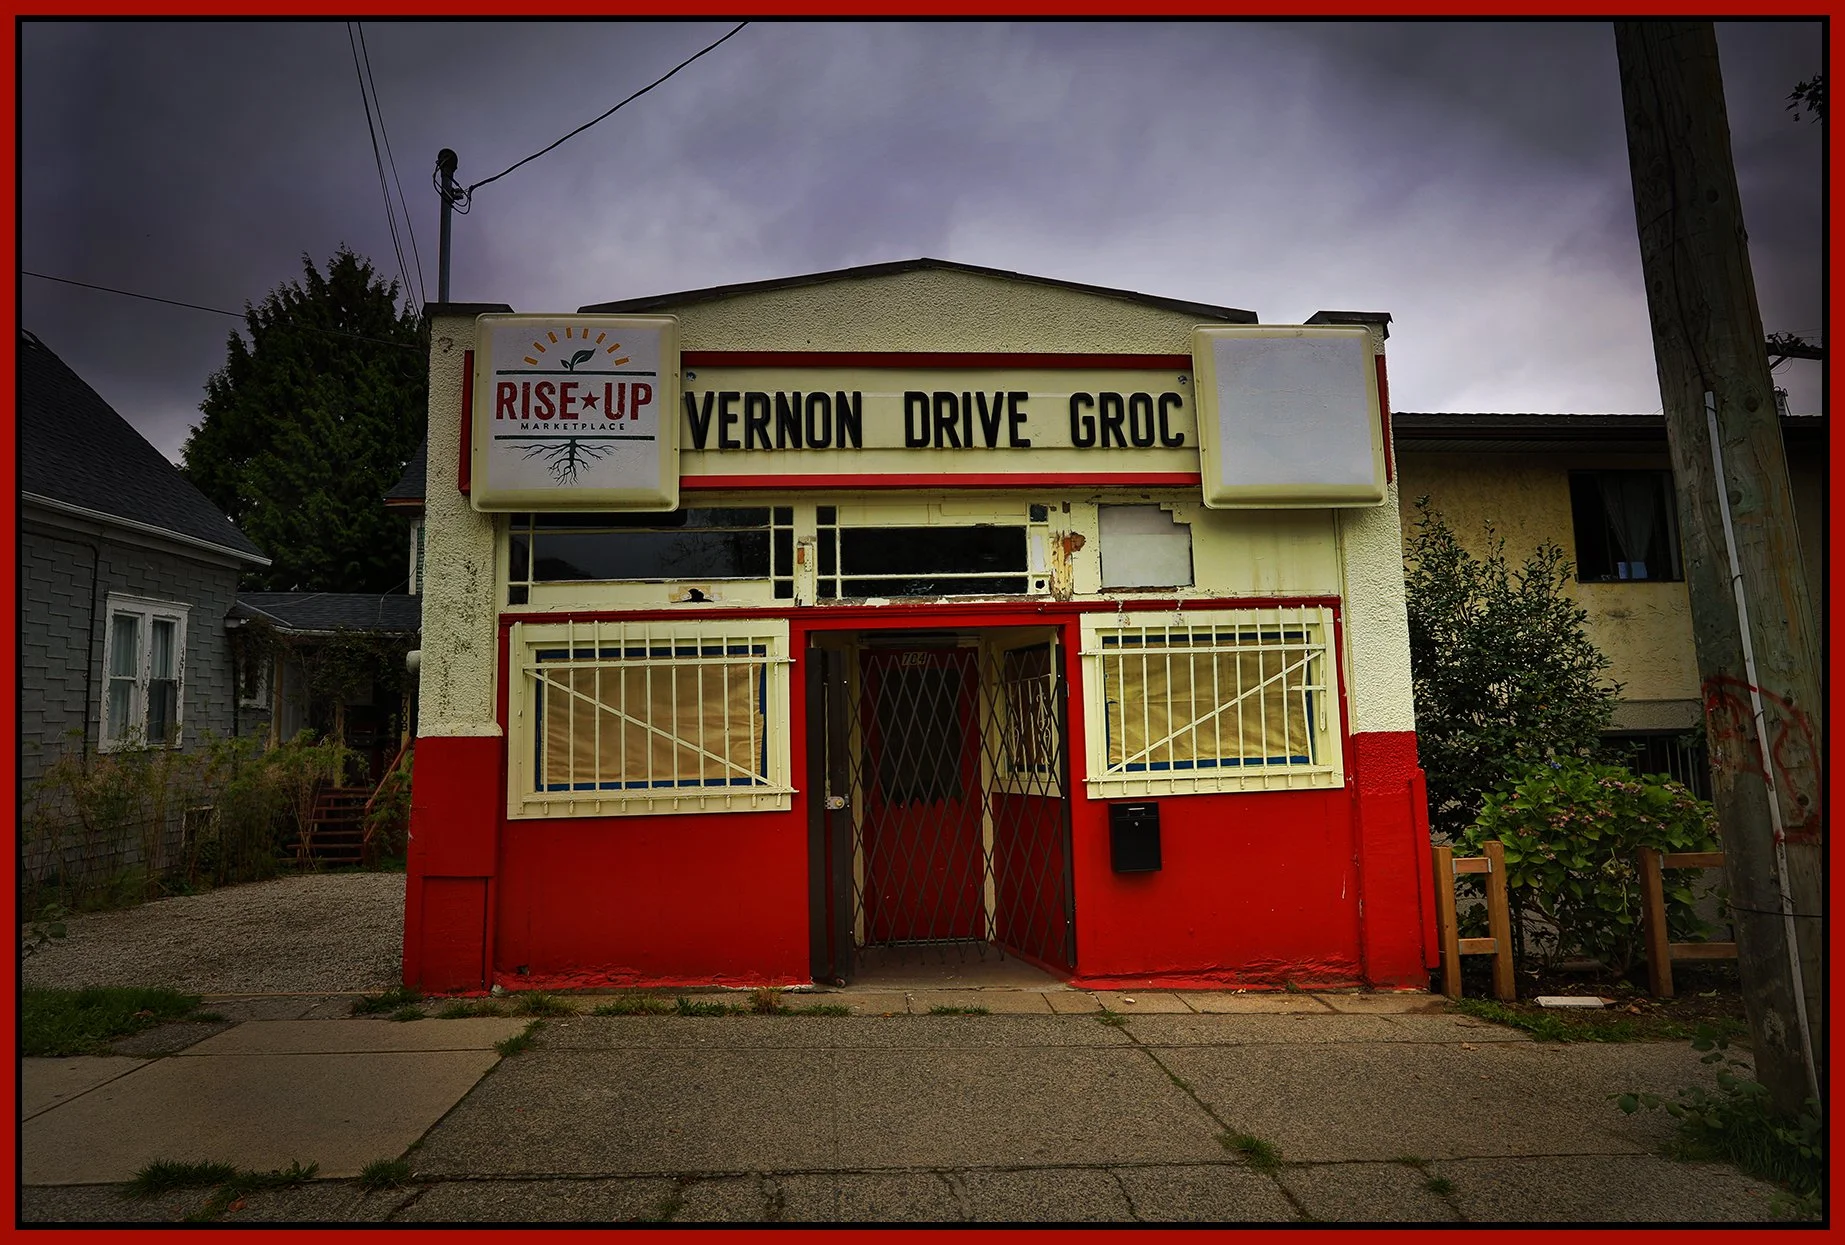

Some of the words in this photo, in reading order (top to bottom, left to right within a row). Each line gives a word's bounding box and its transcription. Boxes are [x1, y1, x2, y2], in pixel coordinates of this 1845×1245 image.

[495, 381, 580, 420] RISE
[604, 382, 653, 421] UP
[520, 422, 625, 431] MARKETPLACE
[686, 391, 863, 449] VERNON
[904, 391, 1031, 449] DRIVE
[1070, 391, 1185, 449] GROC
[904, 652, 925, 664] 704
